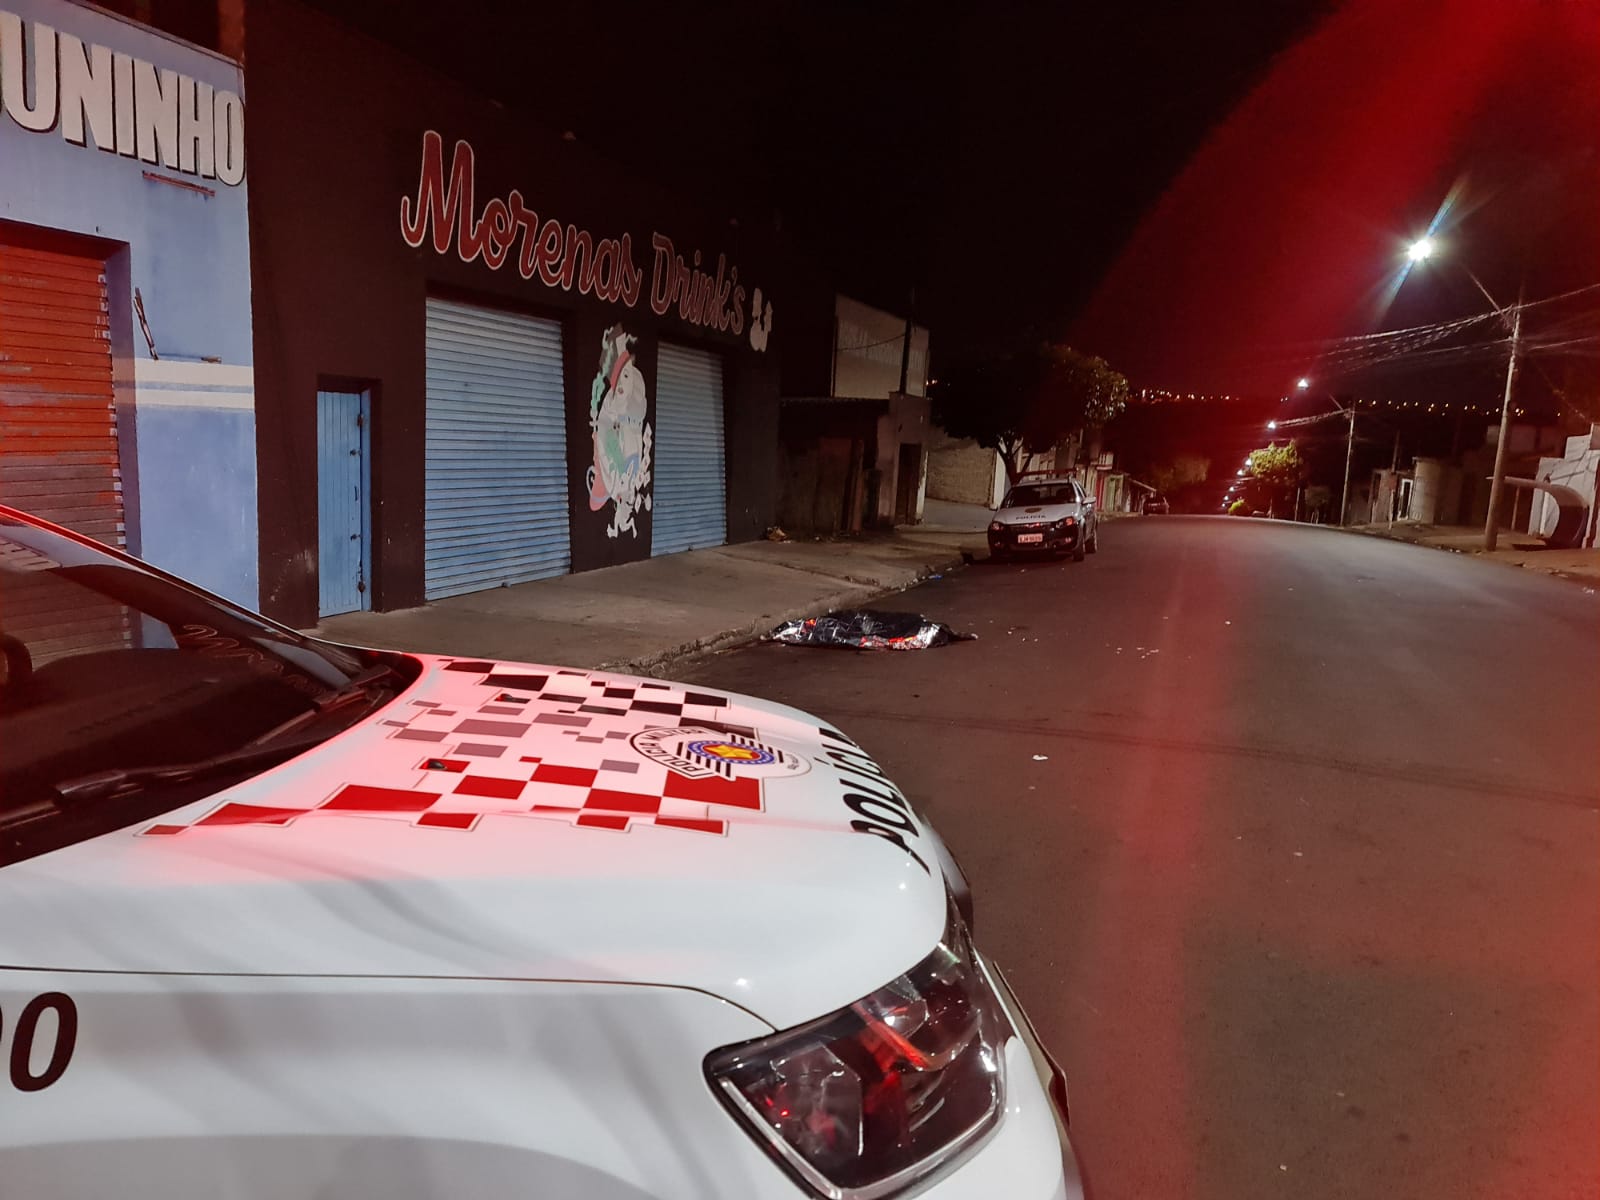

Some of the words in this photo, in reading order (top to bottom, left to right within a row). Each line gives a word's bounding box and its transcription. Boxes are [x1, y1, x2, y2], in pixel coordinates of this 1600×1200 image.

[401, 130, 643, 307] Morenas
[651, 231, 745, 335] Drink's
[0, 991, 78, 1093] 0
